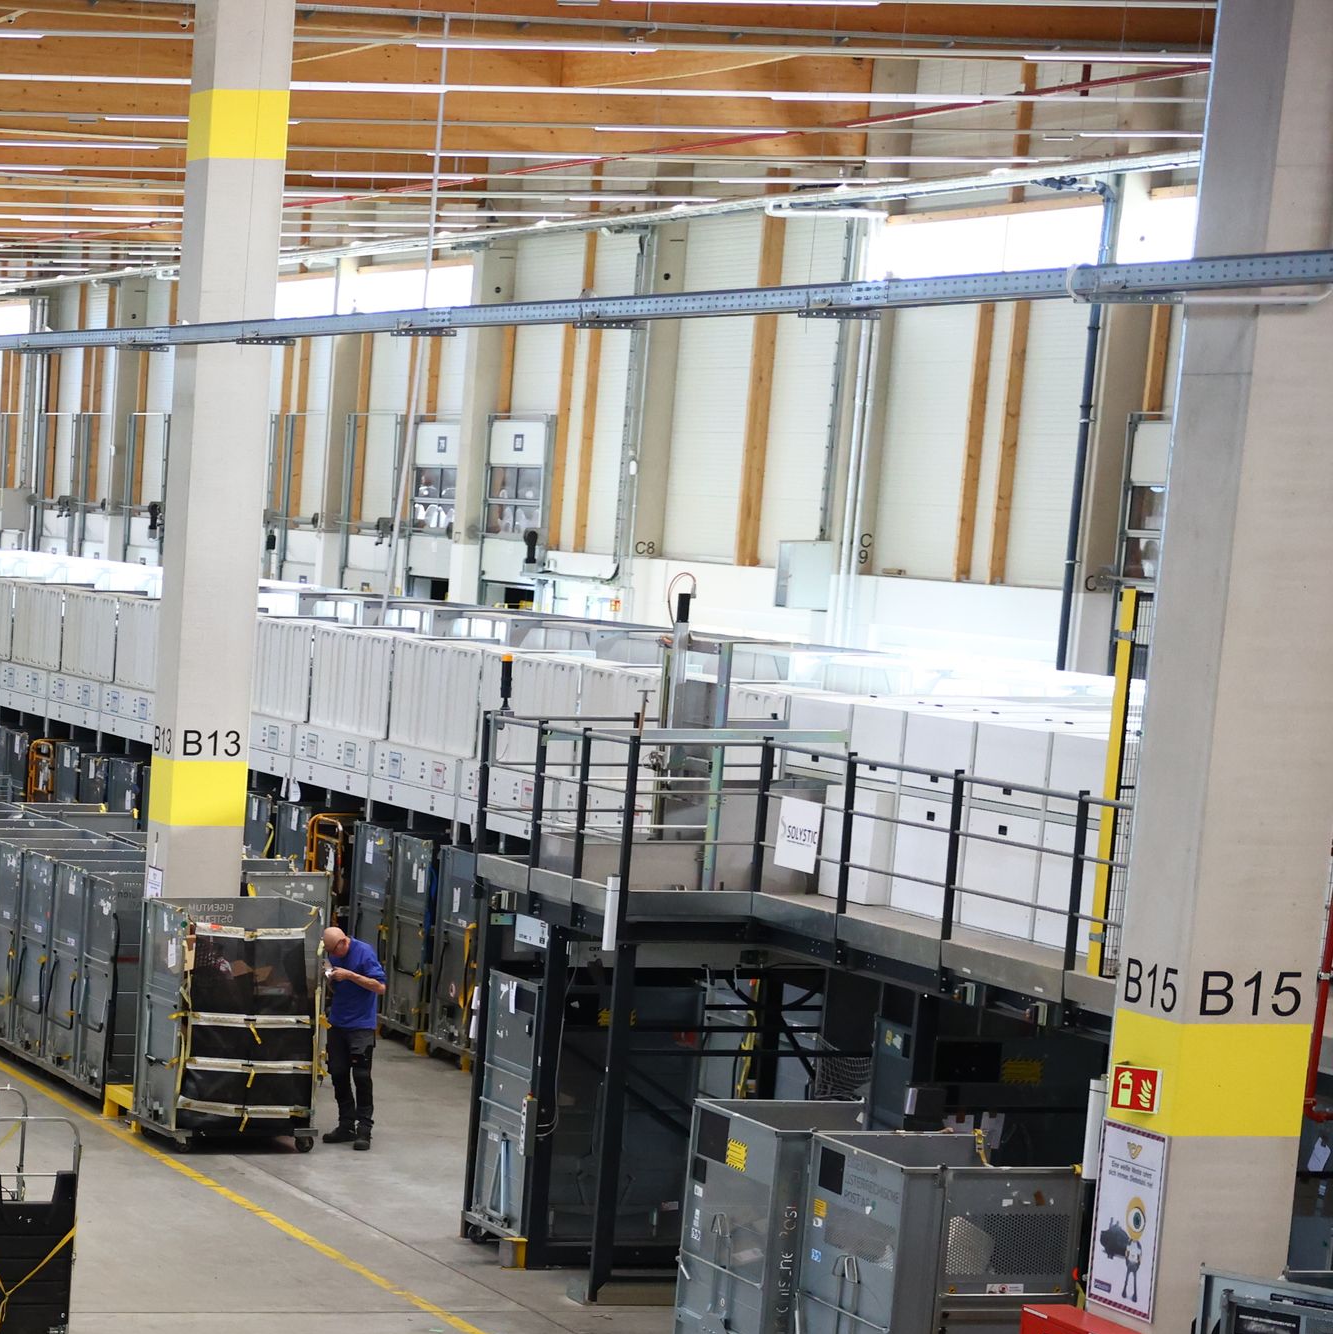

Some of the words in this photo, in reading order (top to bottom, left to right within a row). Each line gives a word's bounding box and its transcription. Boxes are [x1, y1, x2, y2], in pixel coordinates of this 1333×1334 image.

[635, 541, 655, 555] C8
[153, 725, 172, 755] B13
[182, 729, 241, 757] B13
[786, 825, 817, 845] SOLYSTIC
[1124, 957, 1178, 1013] B15
[1199, 970, 1302, 1017] B15
